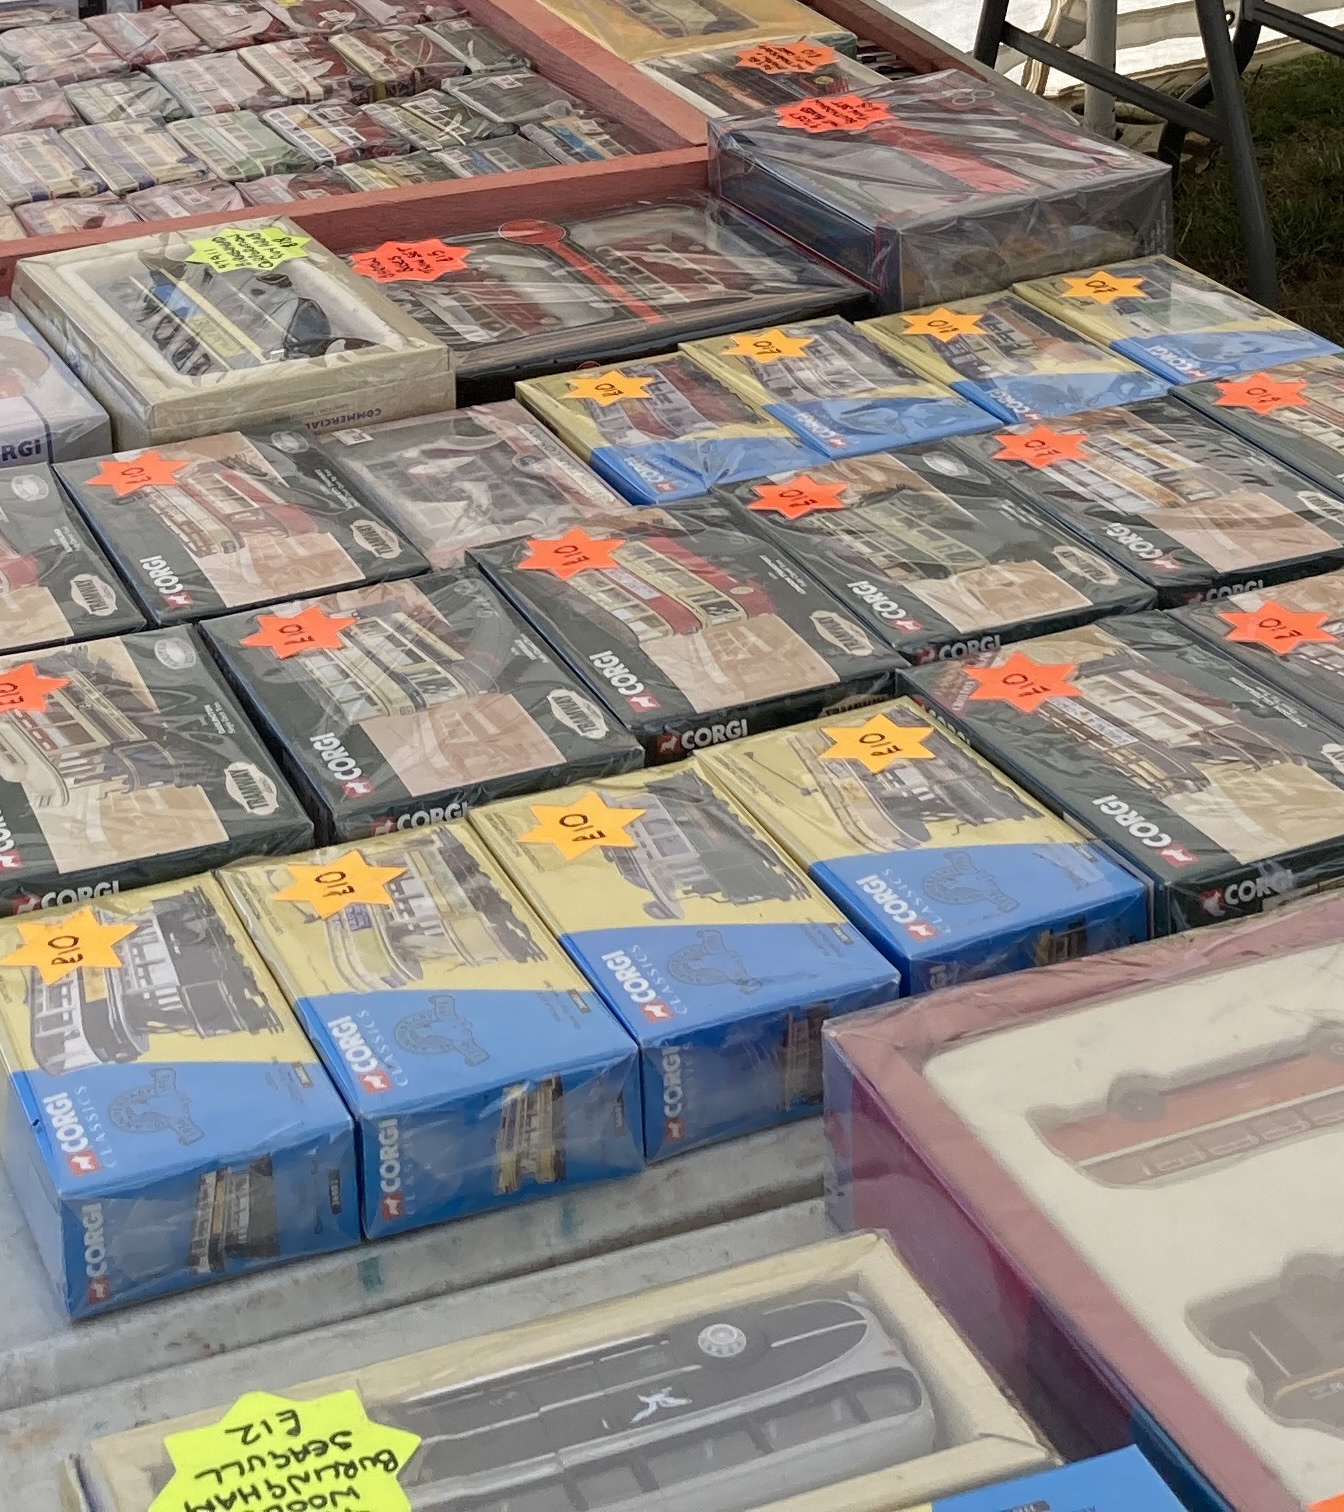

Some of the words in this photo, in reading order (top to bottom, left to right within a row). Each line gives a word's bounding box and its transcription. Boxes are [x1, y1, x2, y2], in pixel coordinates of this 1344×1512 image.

[927, 319, 959, 334] £10
[753, 340, 783, 355] £10
[594, 383, 624, 398] £10
[305, 408, 382, 431] COMMERCIAL
[1023, 439, 1062, 459] £10
[120, 466, 152, 484] £10
[777, 488, 816, 509] £10
[553, 545, 591, 567] £10
[138, 554, 185, 596] CORGI
[846, 579, 907, 621] CORGI
[279, 623, 316, 646] £10
[1257, 616, 1304, 643] £10
[939, 634, 1002, 661] CORGI
[588, 649, 646, 697] CORGI
[1001, 672, 1051, 699] £10
[680, 718, 749, 751] CORGI
[859, 732, 904, 758] £10
[309, 732, 363, 782] CORGI
[396, 800, 469, 834] CORGI
[558, 813, 607, 843] £10
[1092, 794, 1175, 848] CORGI
[315, 870, 356, 898] £10
[855, 873, 918, 927] CORGI
[1224, 869, 1293, 906] COR
[47, 934, 85, 966] £10
[600, 949, 658, 1006] CORGI
[327, 1014, 378, 1074] CORGI
[661, 1044, 684, 1119] CORGI
[42, 1090, 90, 1156] CORGI
[378, 1118, 401, 1194] CORGI
[81, 1202, 108, 1280] CORGI
[193, 1430, 354, 1485] SEAGULL
[184, 1448, 400, 1512] BURLINGHAM
